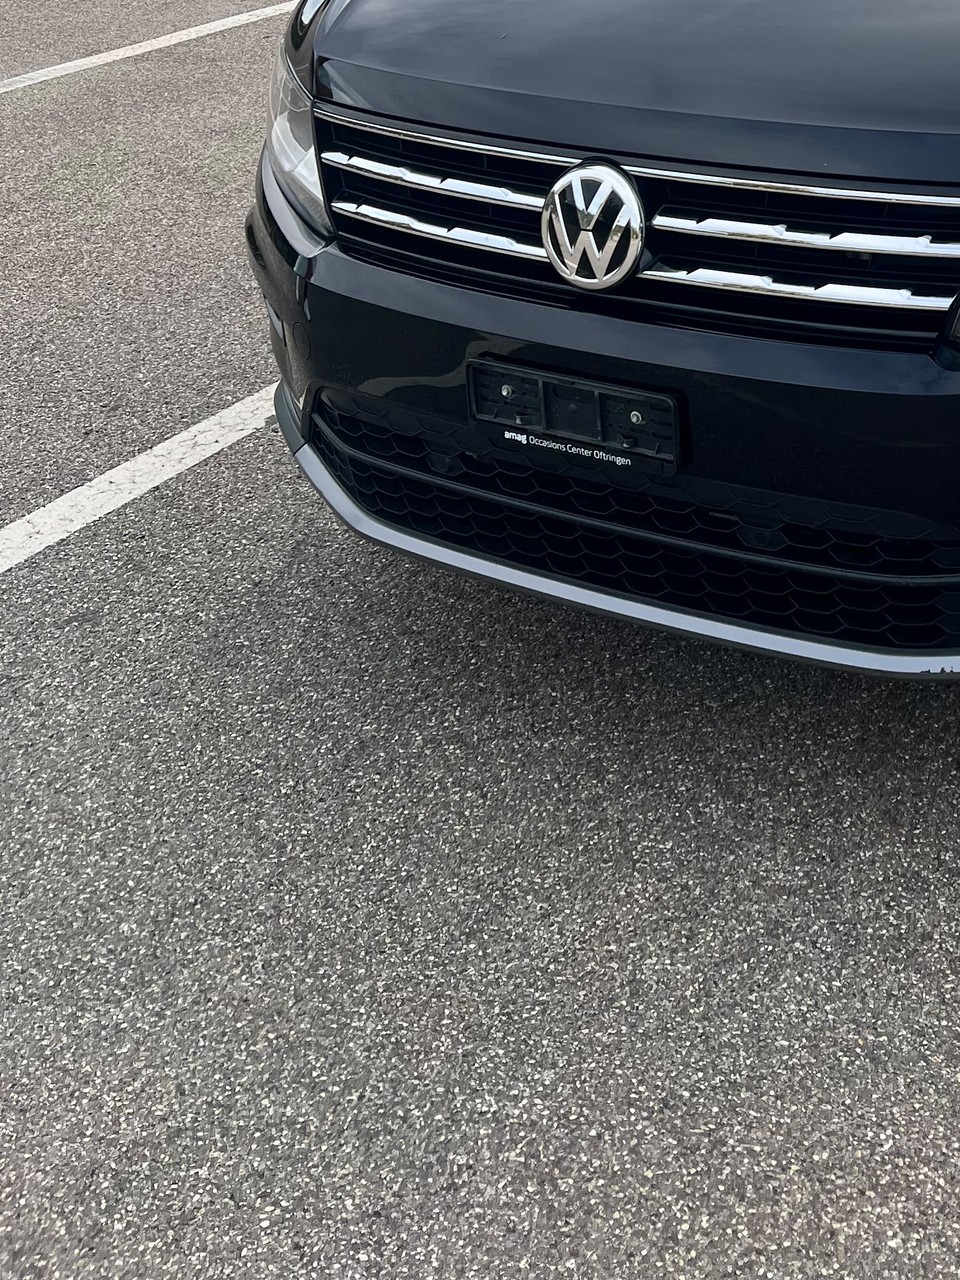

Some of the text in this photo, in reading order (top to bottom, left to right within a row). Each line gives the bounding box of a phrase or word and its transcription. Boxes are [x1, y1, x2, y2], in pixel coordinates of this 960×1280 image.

[546, 168, 638, 284] VW
[504, 430, 631, 466] amag Occasions Center Oftringen
